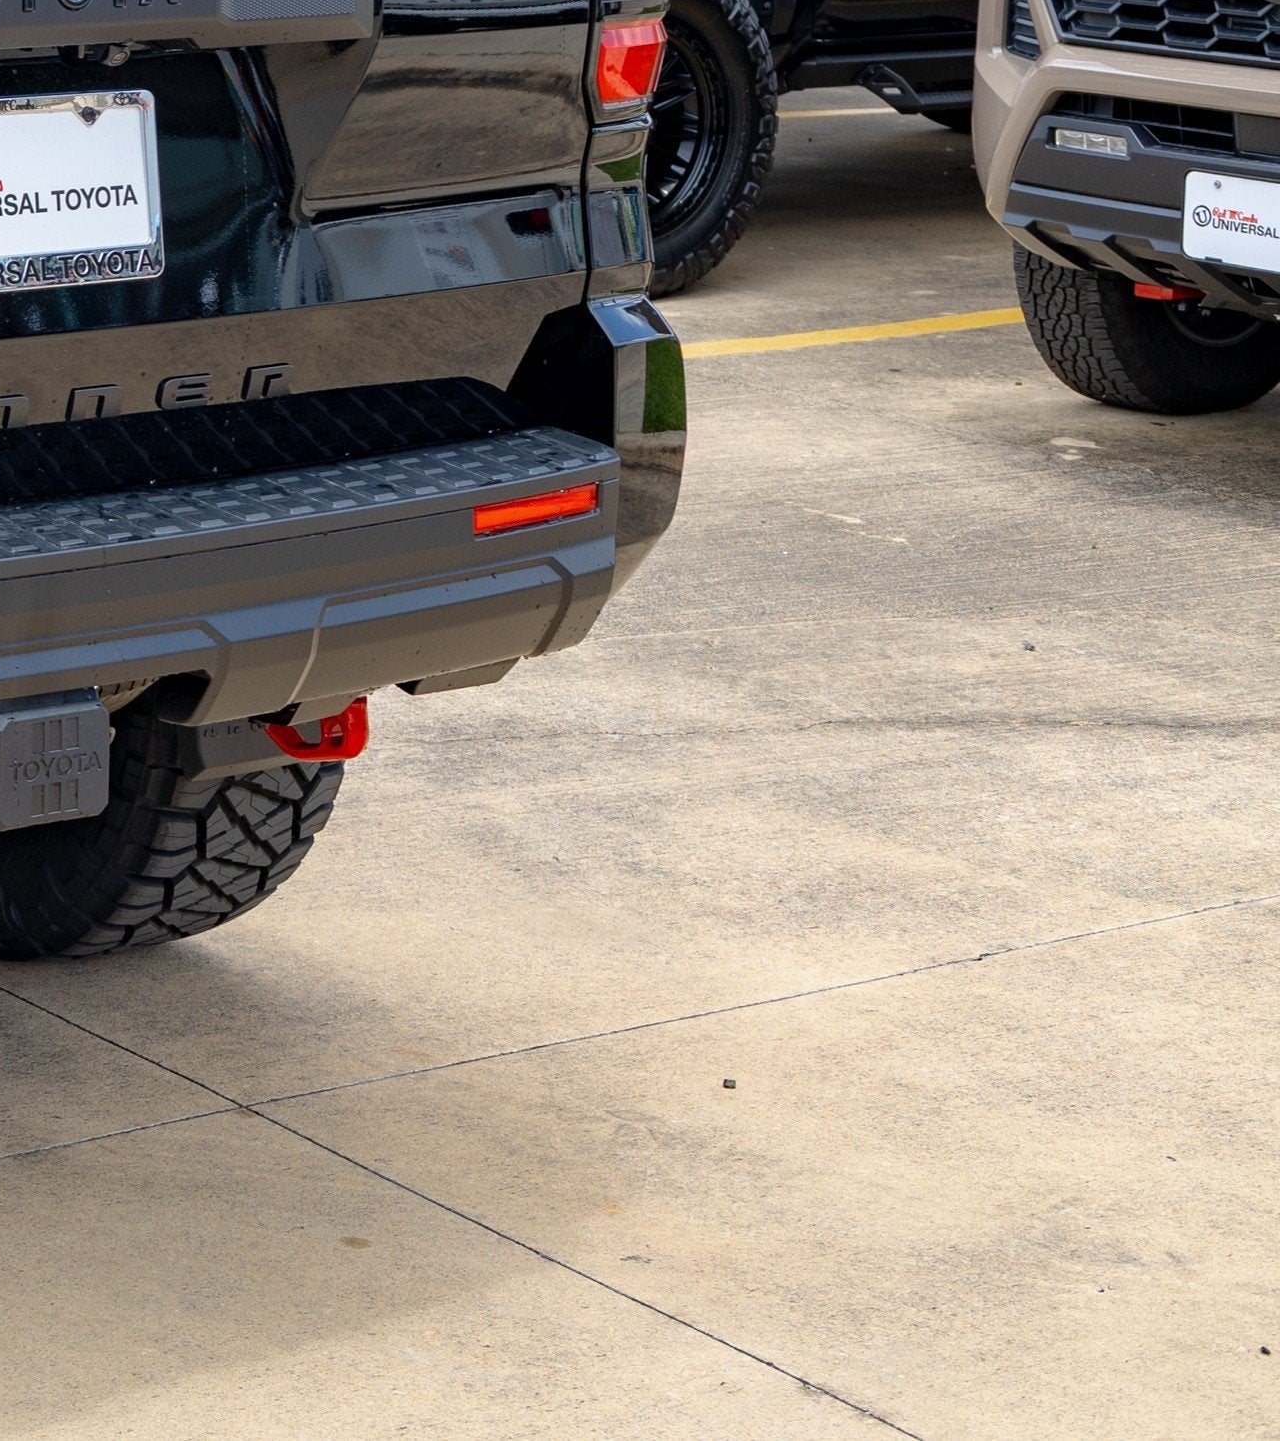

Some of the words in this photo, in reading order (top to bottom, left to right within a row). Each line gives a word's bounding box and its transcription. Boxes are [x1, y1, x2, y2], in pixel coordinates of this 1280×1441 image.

[51, 185, 138, 218] TOYOTA
[1213, 218, 1280, 239] UNIVERSAL
[56, 249, 155, 280] TOYOTA
[9, 751, 102, 782] TOYOTA
